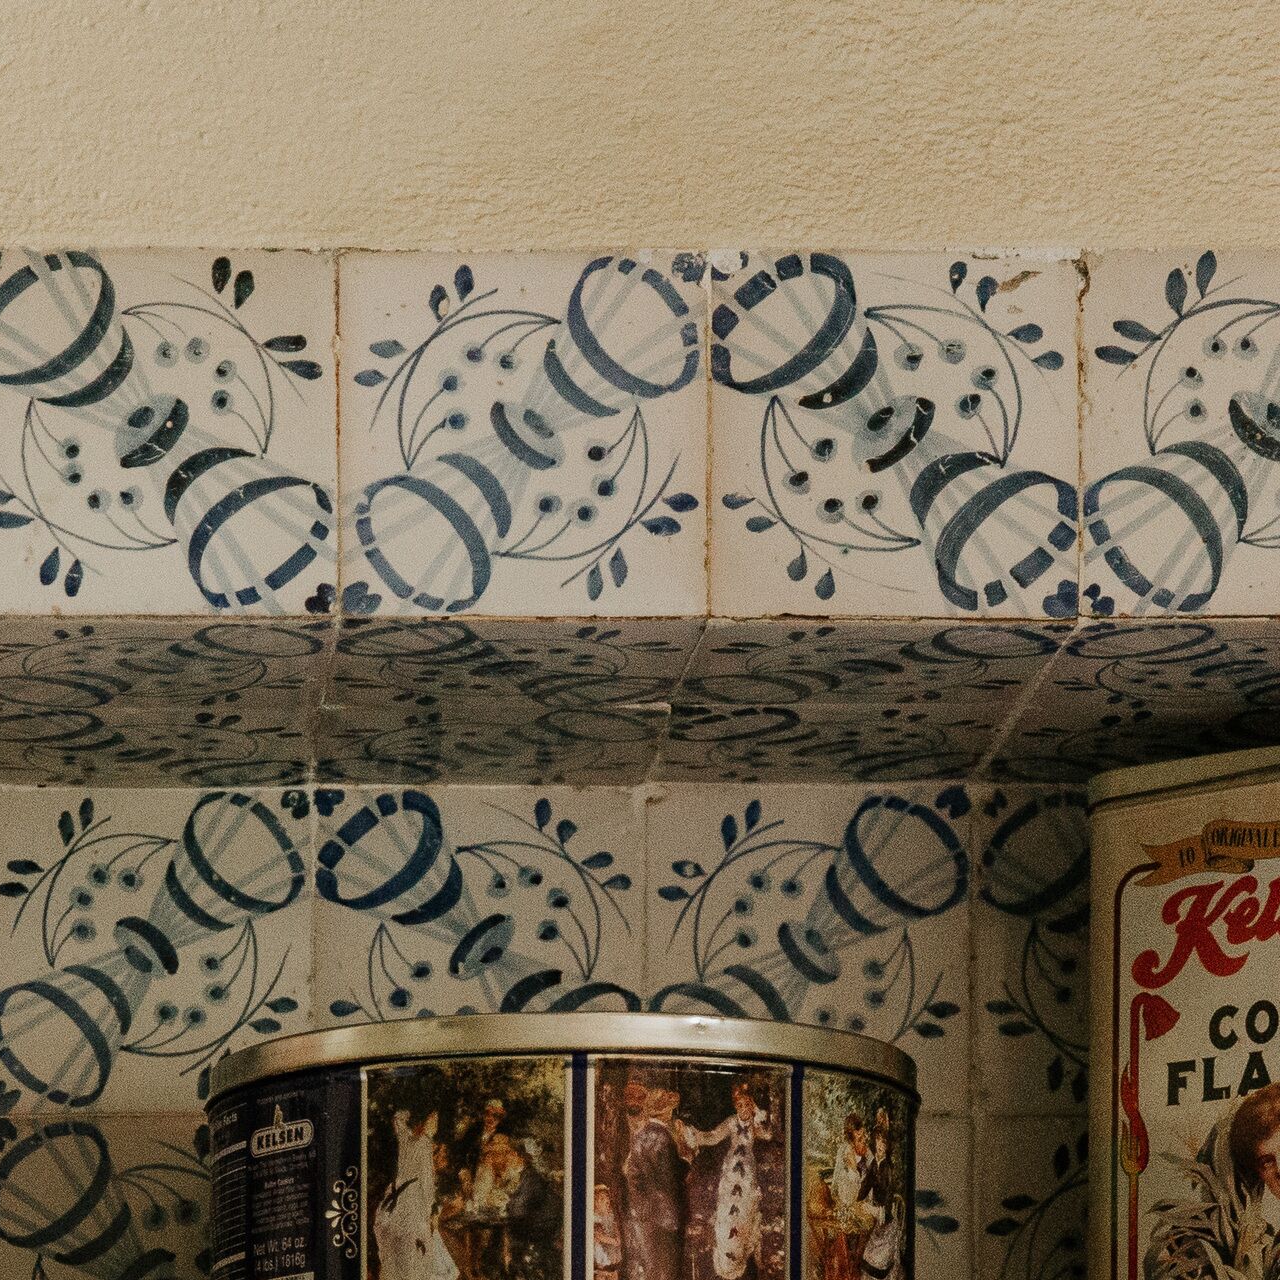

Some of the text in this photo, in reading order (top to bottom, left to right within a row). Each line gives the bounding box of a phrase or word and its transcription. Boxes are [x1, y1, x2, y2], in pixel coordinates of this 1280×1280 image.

[1179, 848, 1195, 868] LO
[1210, 826, 1268, 849] ORIGINAL
[256, 1126, 304, 1150] KELSEN
[253, 1243, 266, 1256] Net
[281, 1237, 292, 1251] 64
[281, 1252, 307, 1268] 1816g
